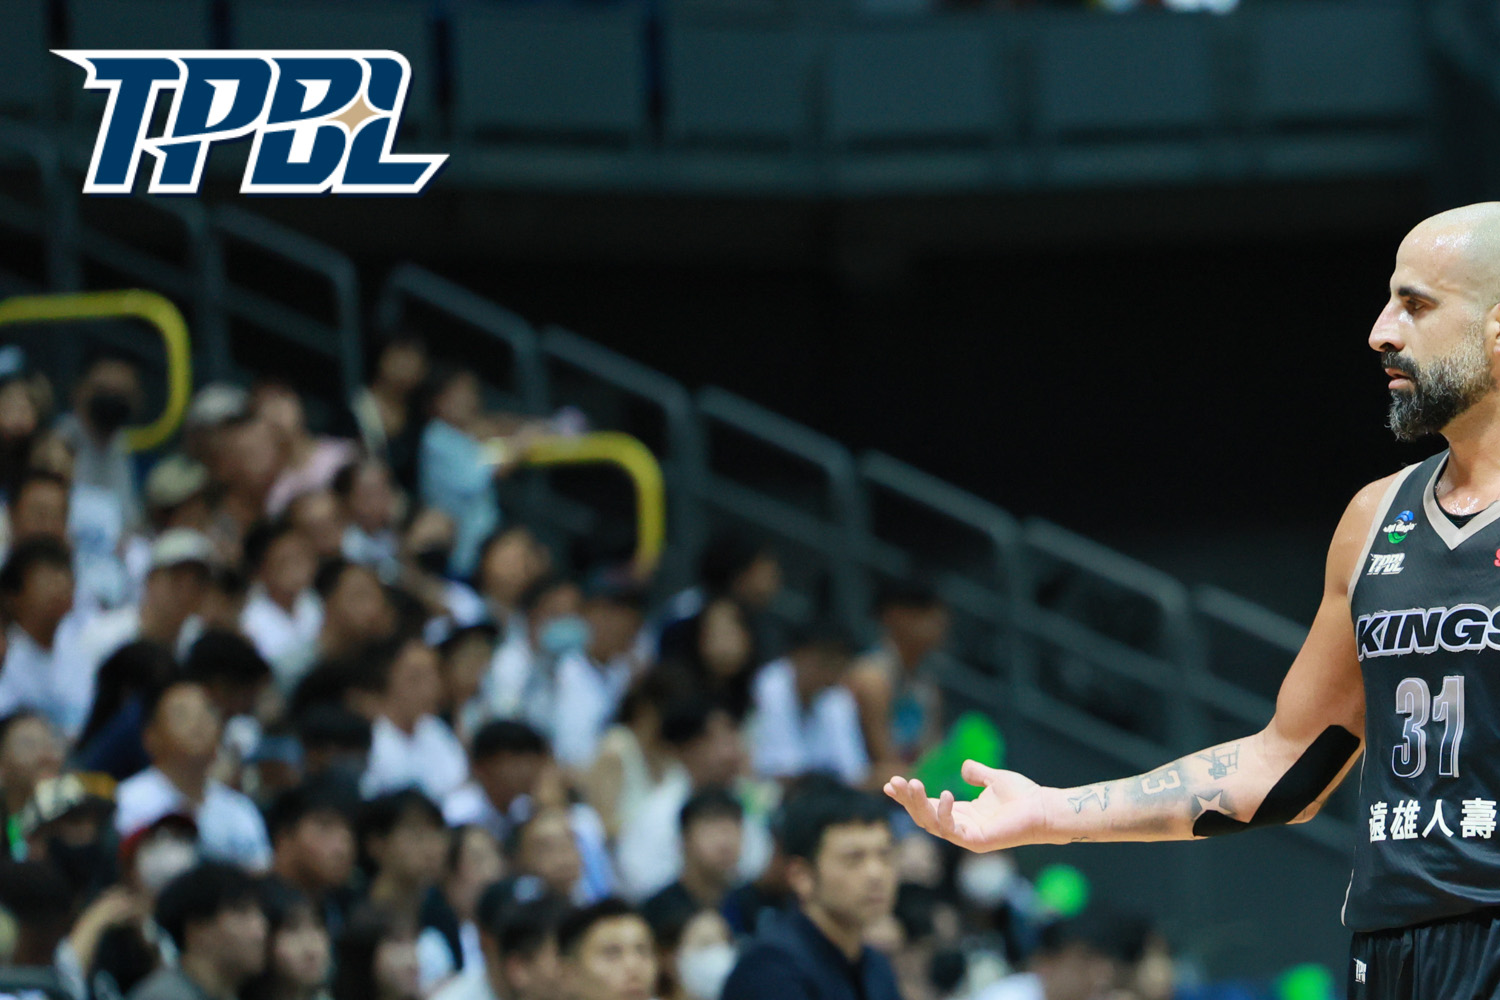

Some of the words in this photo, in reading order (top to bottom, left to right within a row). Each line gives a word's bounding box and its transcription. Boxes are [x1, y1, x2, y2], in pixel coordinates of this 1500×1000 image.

[1366, 552, 1405, 576] TPBL
[1391, 675, 1465, 778] 31
[1368, 797, 1497, 844] 遠雄人壽
